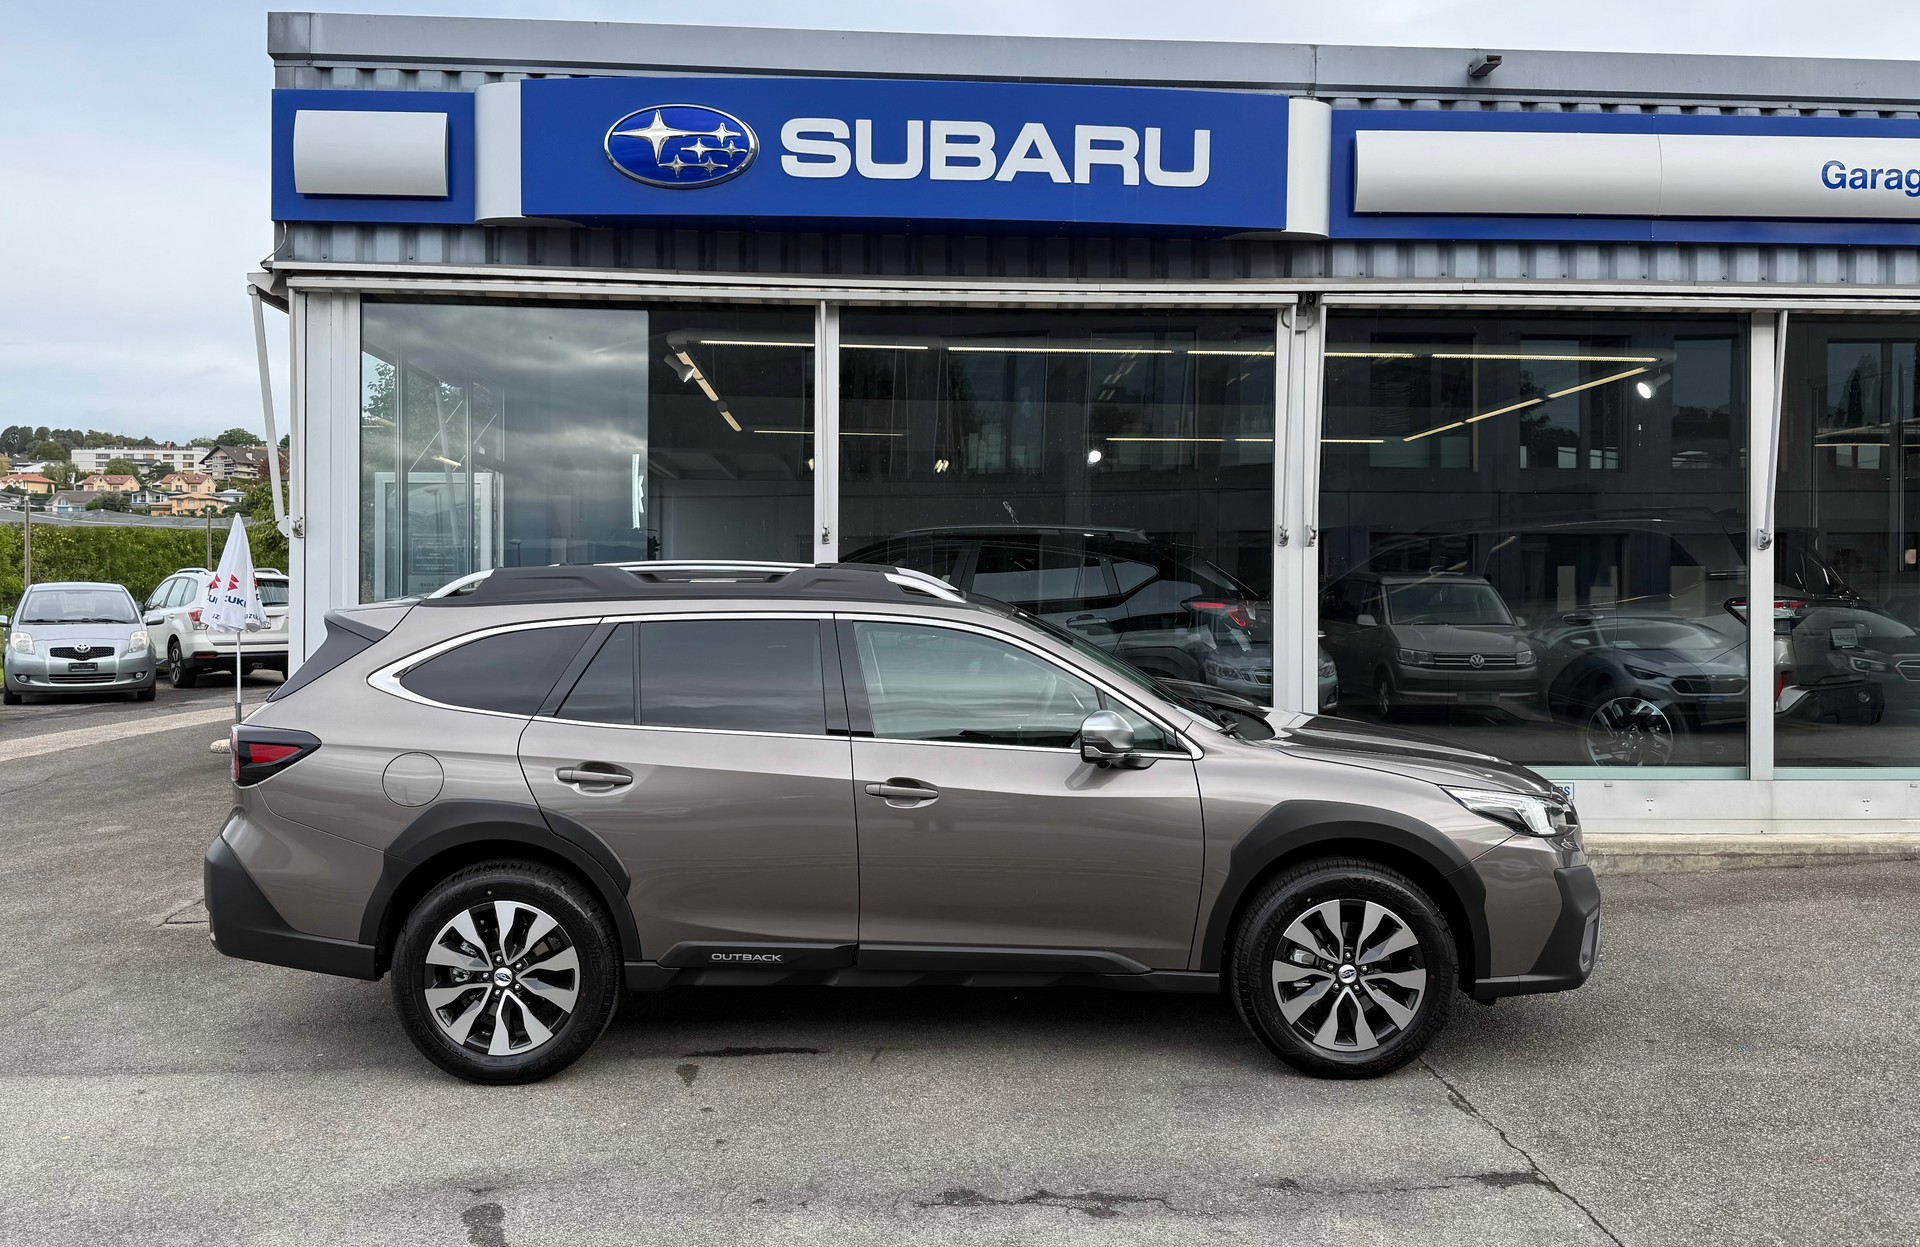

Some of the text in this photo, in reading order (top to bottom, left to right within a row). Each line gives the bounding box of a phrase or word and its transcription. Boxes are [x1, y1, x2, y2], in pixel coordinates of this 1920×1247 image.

[781, 117, 1211, 188] SUBARU
[1821, 160, 1920, 197] Garag
[711, 953, 782, 962] OUTBACK
